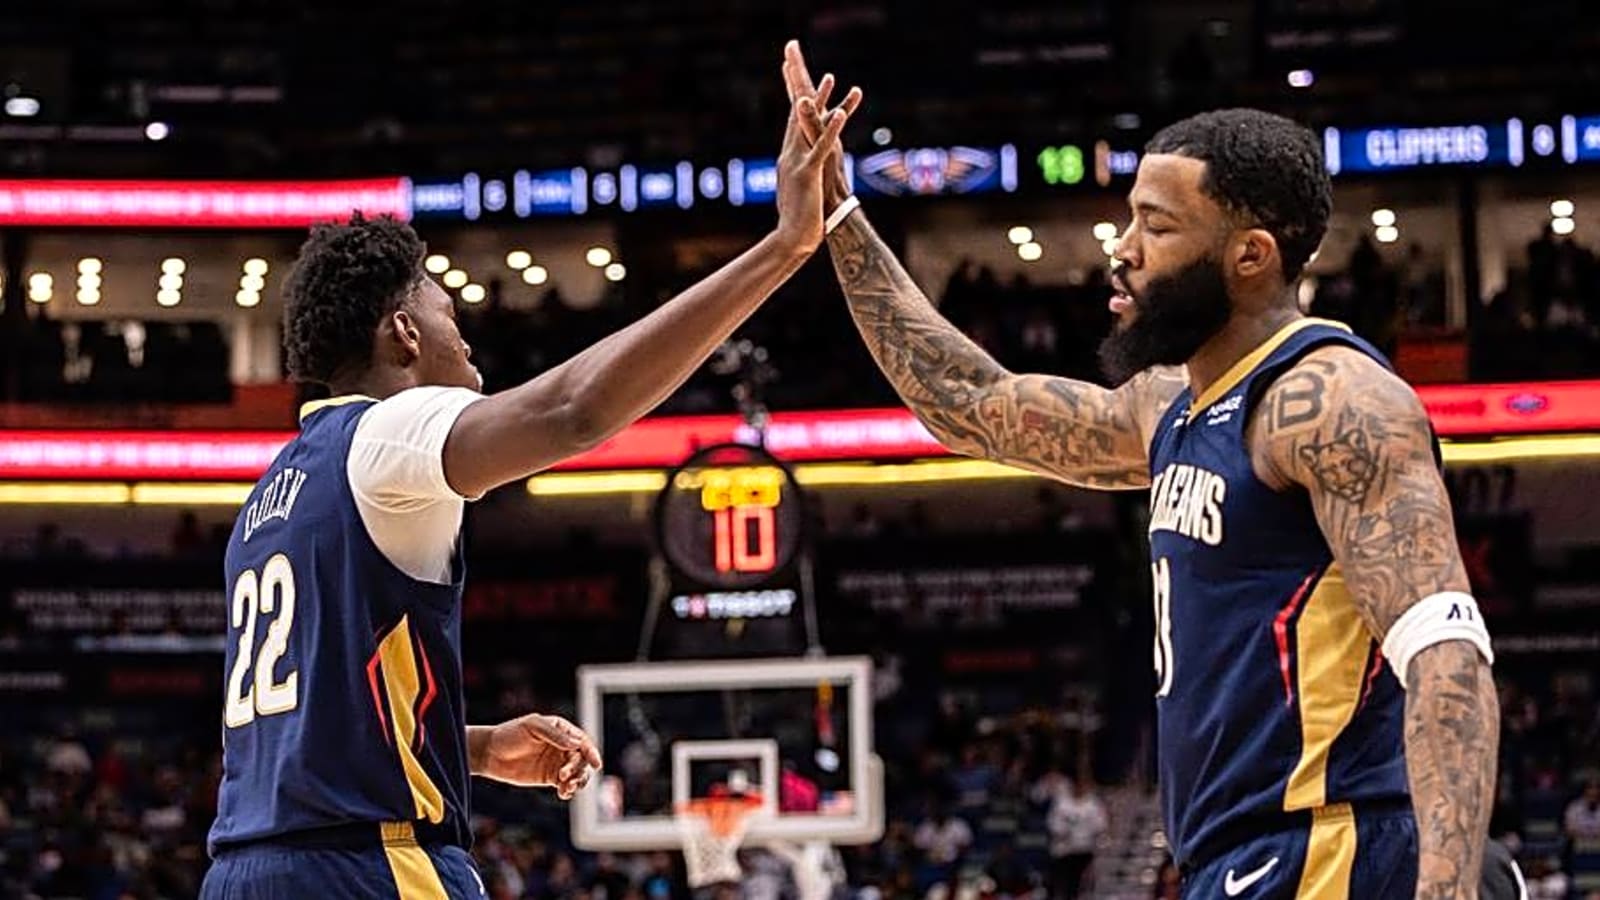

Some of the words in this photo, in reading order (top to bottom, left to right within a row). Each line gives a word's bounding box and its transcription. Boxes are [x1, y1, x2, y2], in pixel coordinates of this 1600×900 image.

[1366, 125, 1488, 166] CLIPPERS
[714, 506, 775, 573] 10
[225, 553, 297, 728] 22
